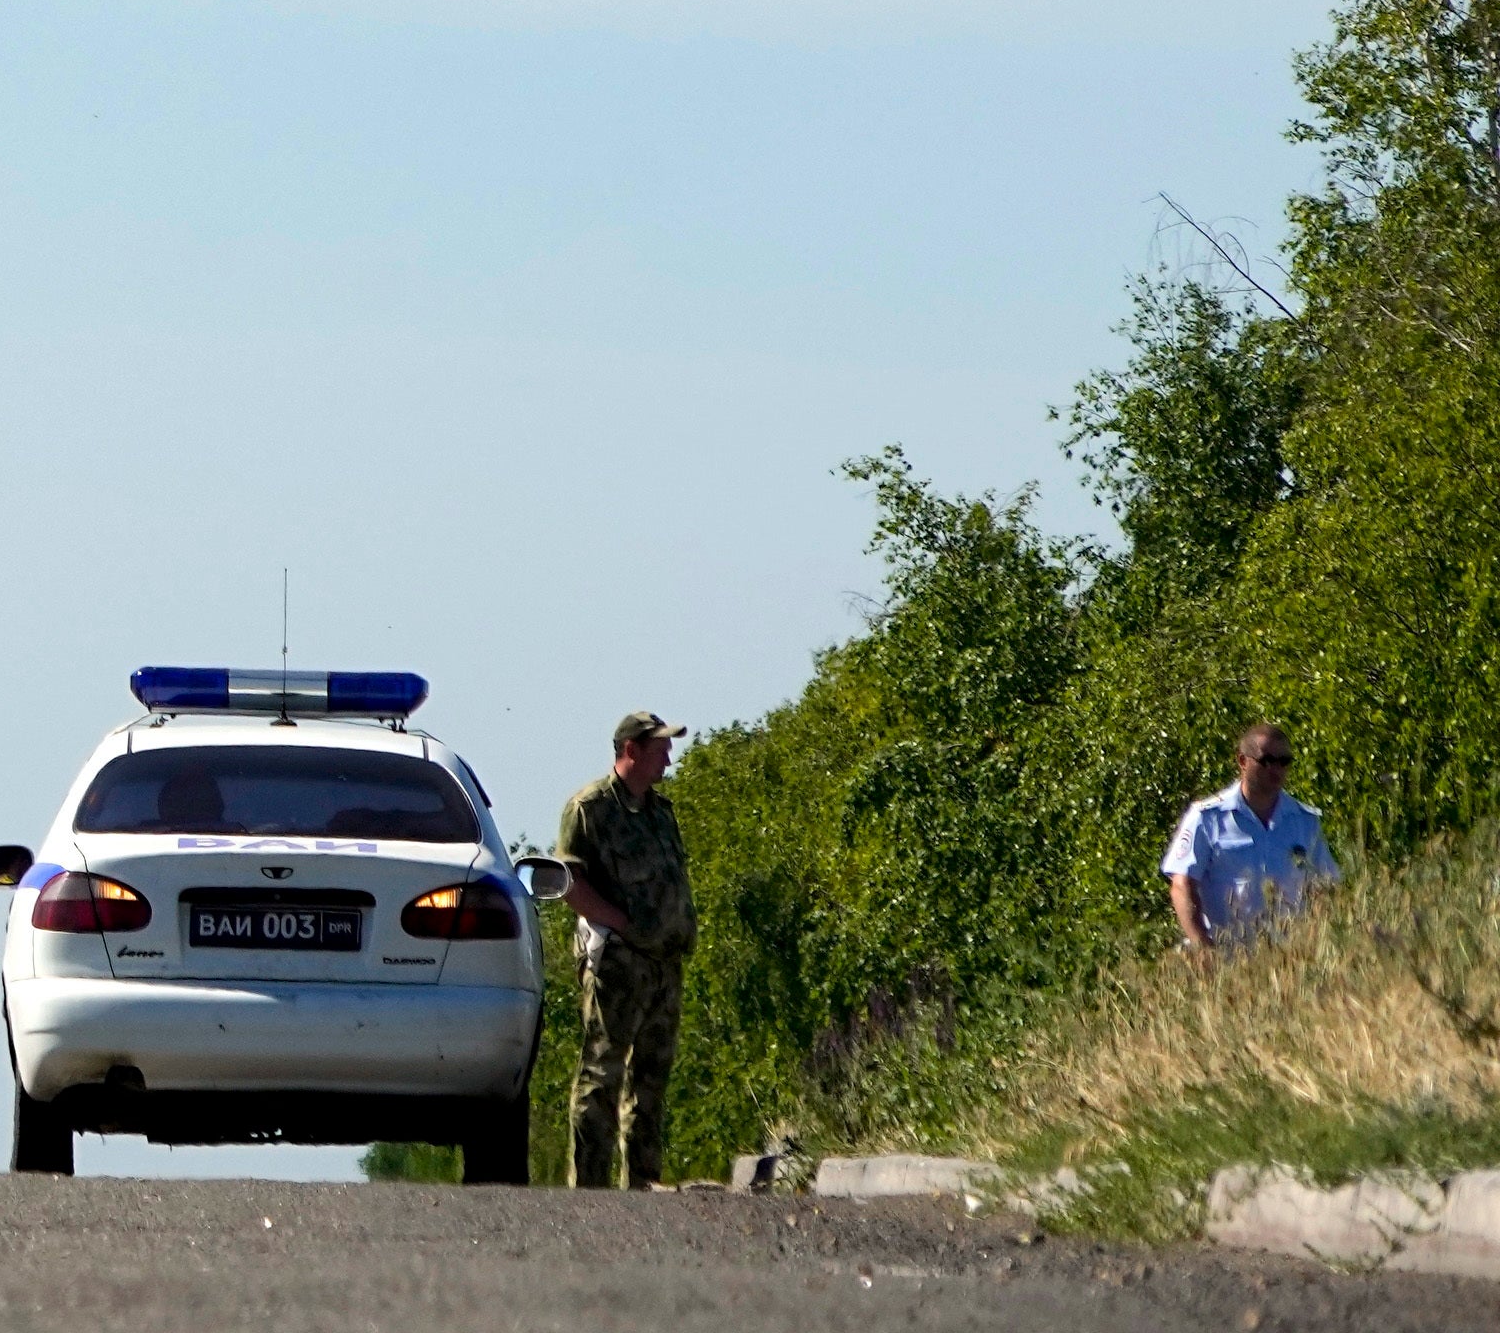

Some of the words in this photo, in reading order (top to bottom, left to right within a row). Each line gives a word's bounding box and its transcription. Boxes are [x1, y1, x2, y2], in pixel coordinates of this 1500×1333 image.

[177, 837, 378, 853] ВАИ
[199, 914, 252, 938] ВАИ
[262, 912, 316, 939] 003
[328, 921, 352, 934] DPR
